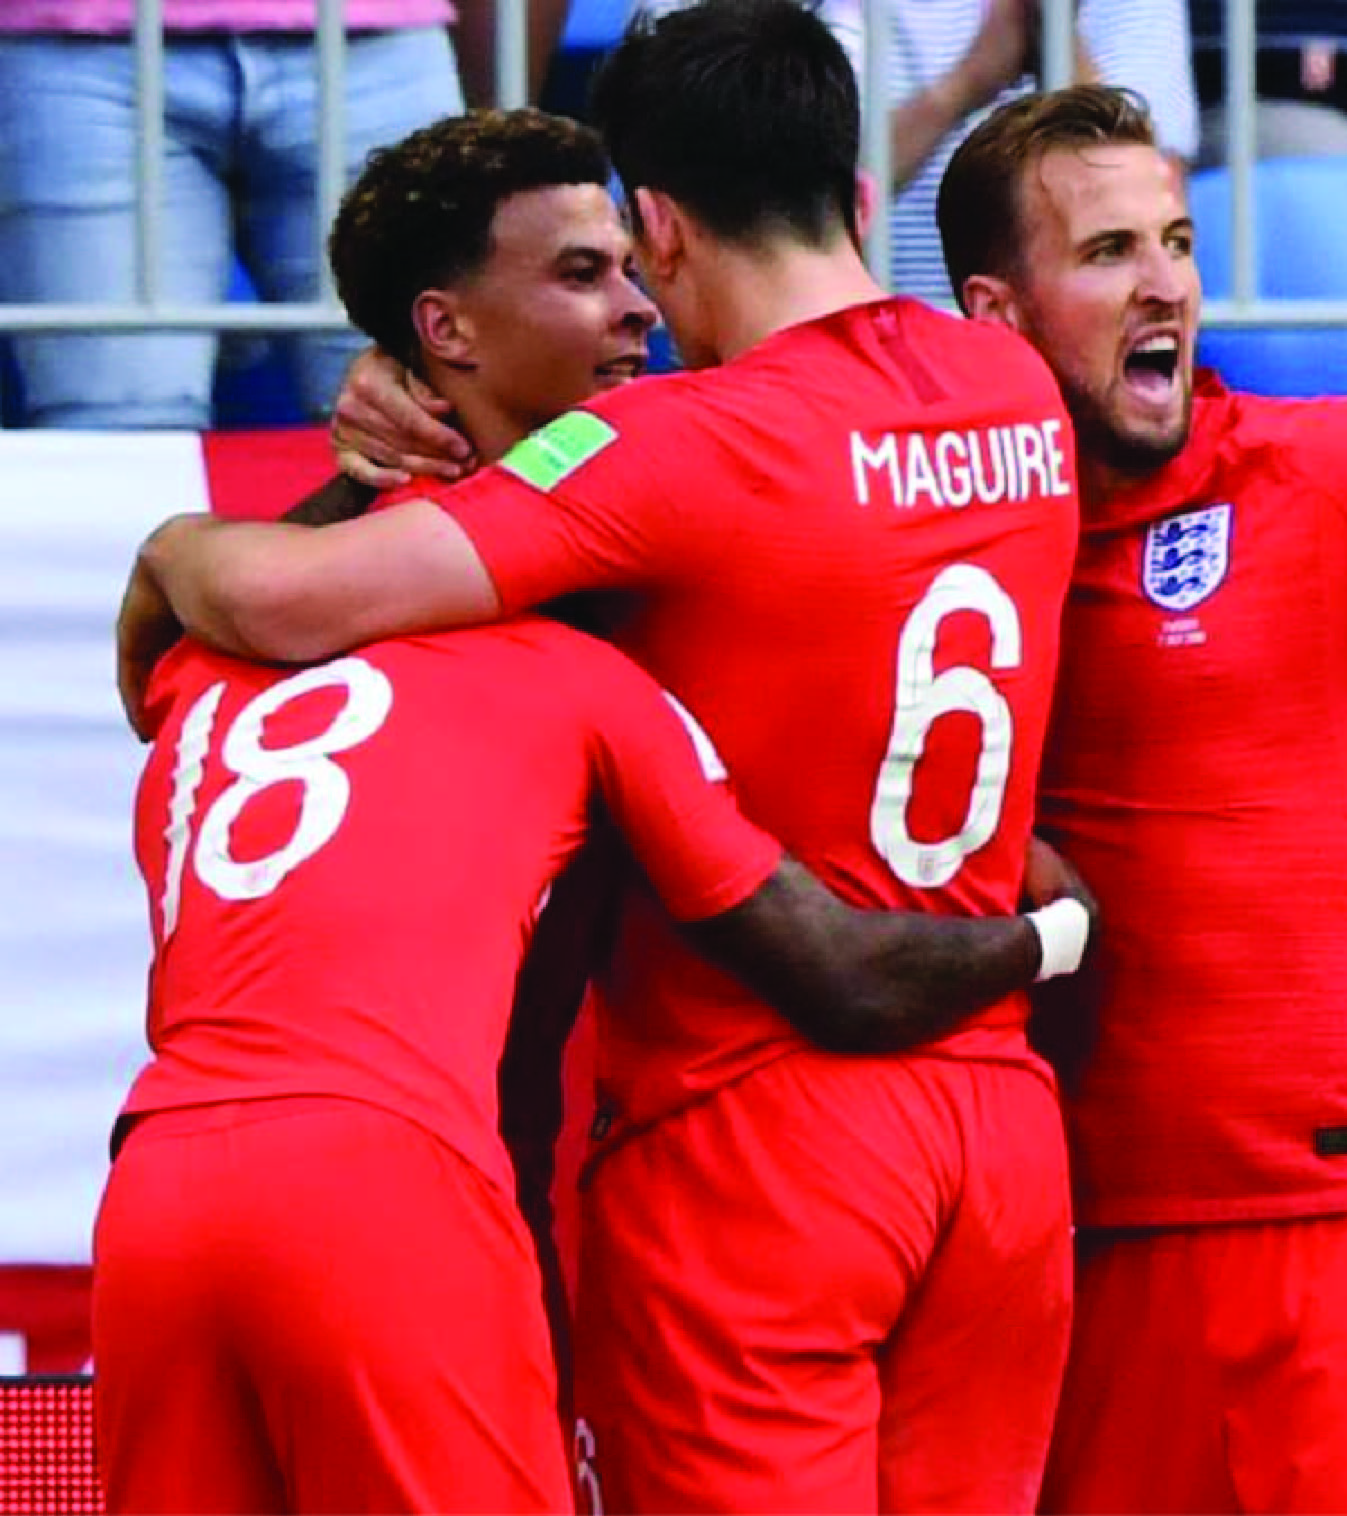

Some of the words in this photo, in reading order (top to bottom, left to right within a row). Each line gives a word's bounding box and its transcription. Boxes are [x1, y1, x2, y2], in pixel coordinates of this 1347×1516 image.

[850, 418, 1071, 508] MAGUIRE
[161, 656, 393, 942] 18
[869, 562, 1022, 889] 6
